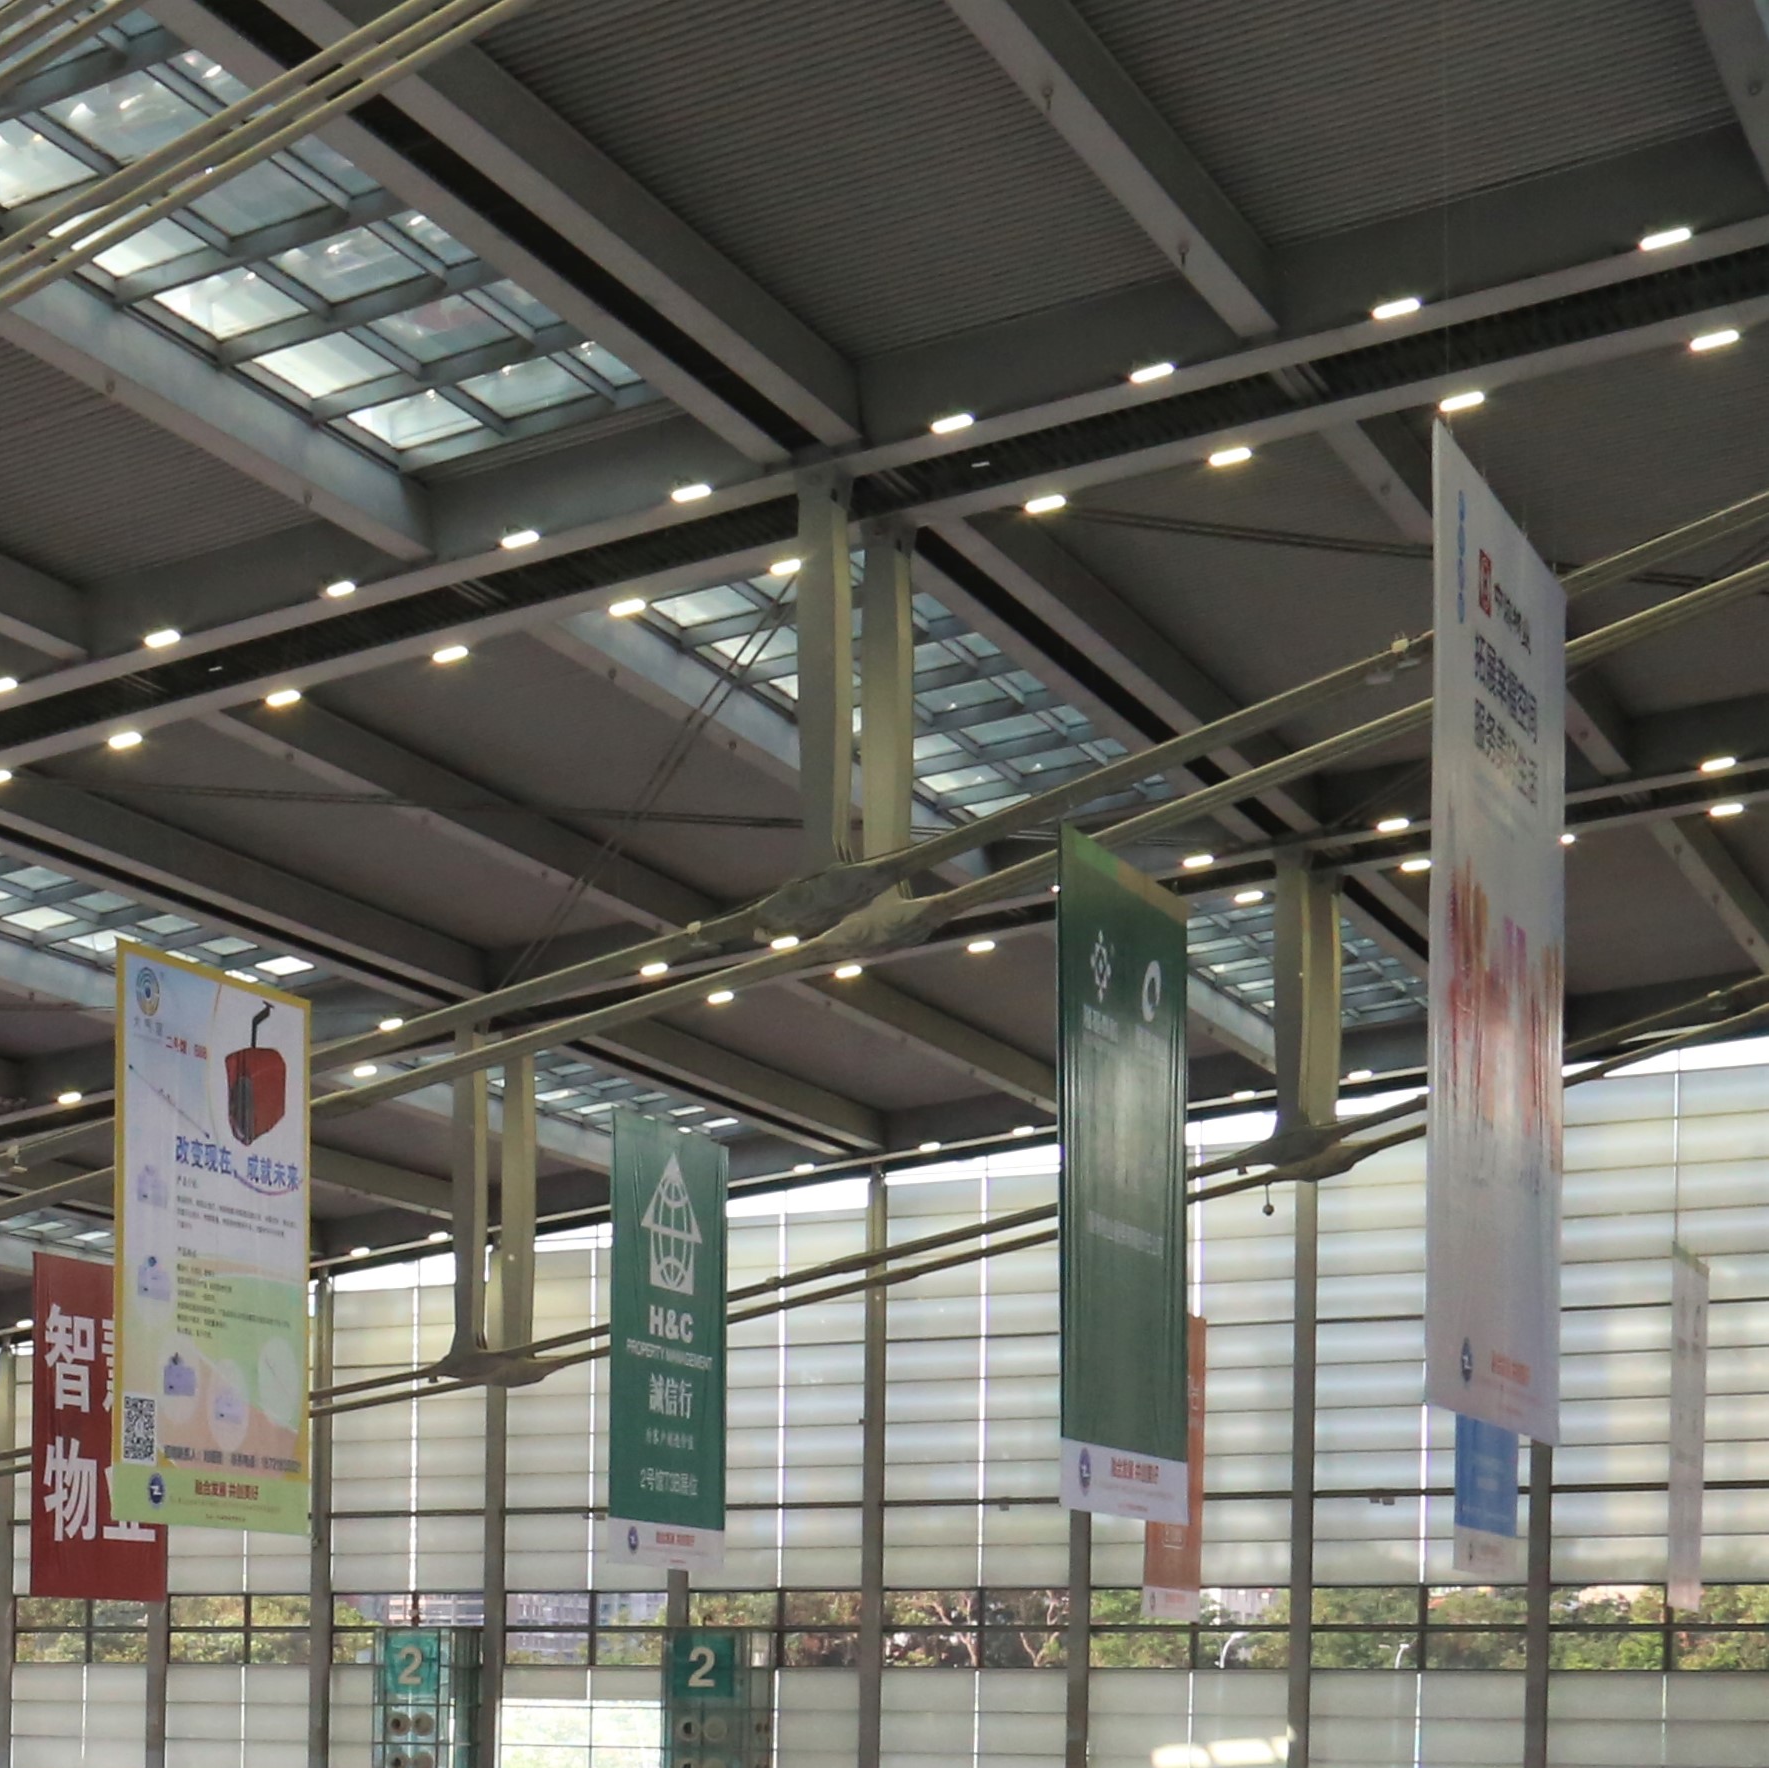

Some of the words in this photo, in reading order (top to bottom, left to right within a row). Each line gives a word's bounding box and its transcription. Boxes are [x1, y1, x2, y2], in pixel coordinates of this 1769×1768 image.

[649, 1305, 694, 1343] H&C
[397, 1646, 423, 1686] 2
[688, 1646, 716, 1688] 2
